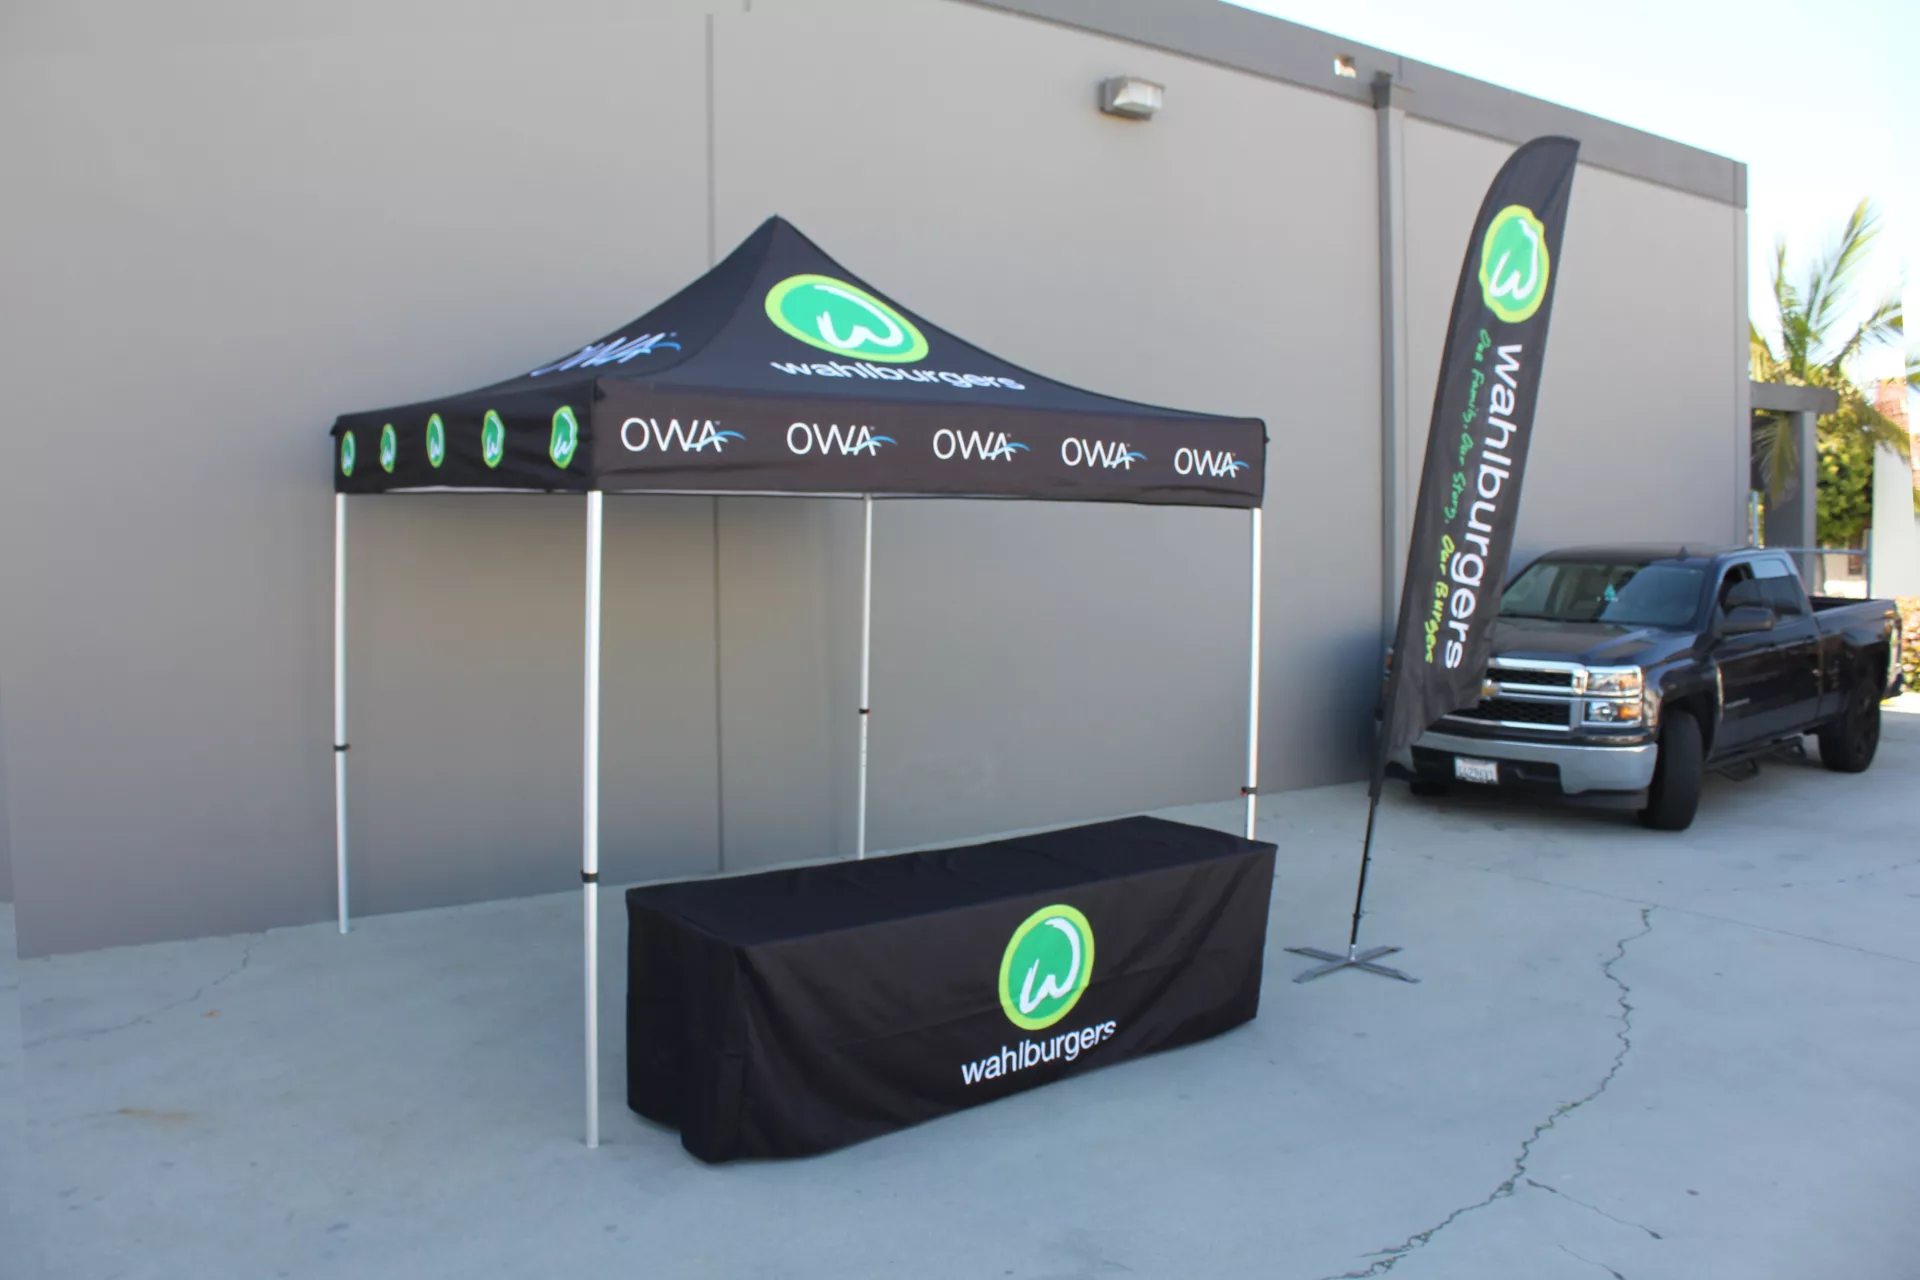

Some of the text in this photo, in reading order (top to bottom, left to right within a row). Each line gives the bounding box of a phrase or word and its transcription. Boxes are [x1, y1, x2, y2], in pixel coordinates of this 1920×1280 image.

[770, 360, 1027, 391] wahlburgers
[620, 417, 1236, 478] OWA OWA OWA OWA OWA
[1444, 343, 1523, 669] wahlburgers
[1440, 533, 1456, 575] Our
[960, 1020, 1117, 1085] wahlburgers
